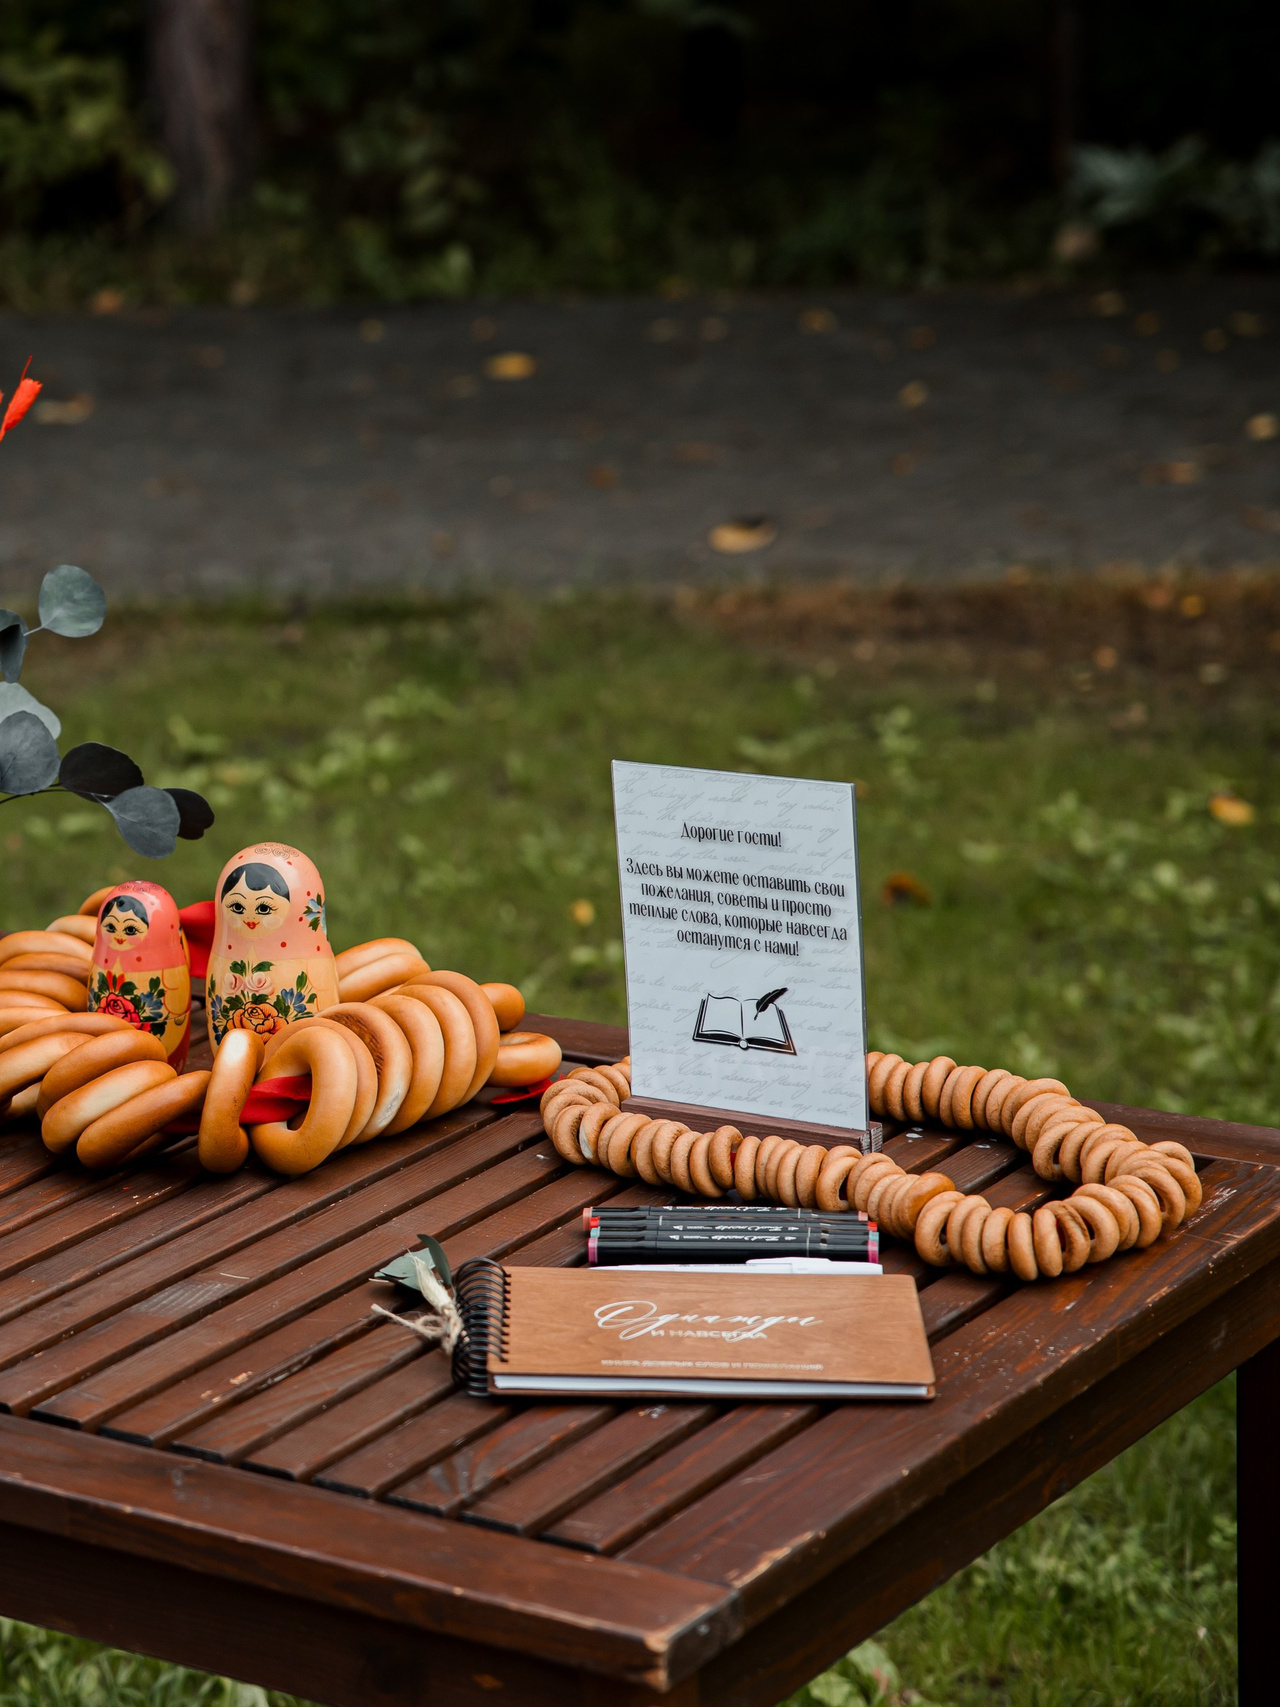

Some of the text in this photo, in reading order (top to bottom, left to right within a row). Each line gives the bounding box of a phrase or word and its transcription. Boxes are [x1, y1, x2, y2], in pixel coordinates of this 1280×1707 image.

[681, 822, 782, 847] Дорогие гости!
[626, 858, 845, 897] Здесь вы можете оставить свои
[641, 883, 831, 918] пожелания, советы и просто
[629, 902, 678, 920] теплые
[682, 909, 721, 927] слова,
[724, 914, 783, 934] которые
[786, 922, 847, 941] навсегда
[677, 929, 799, 957] останутся с нами!
